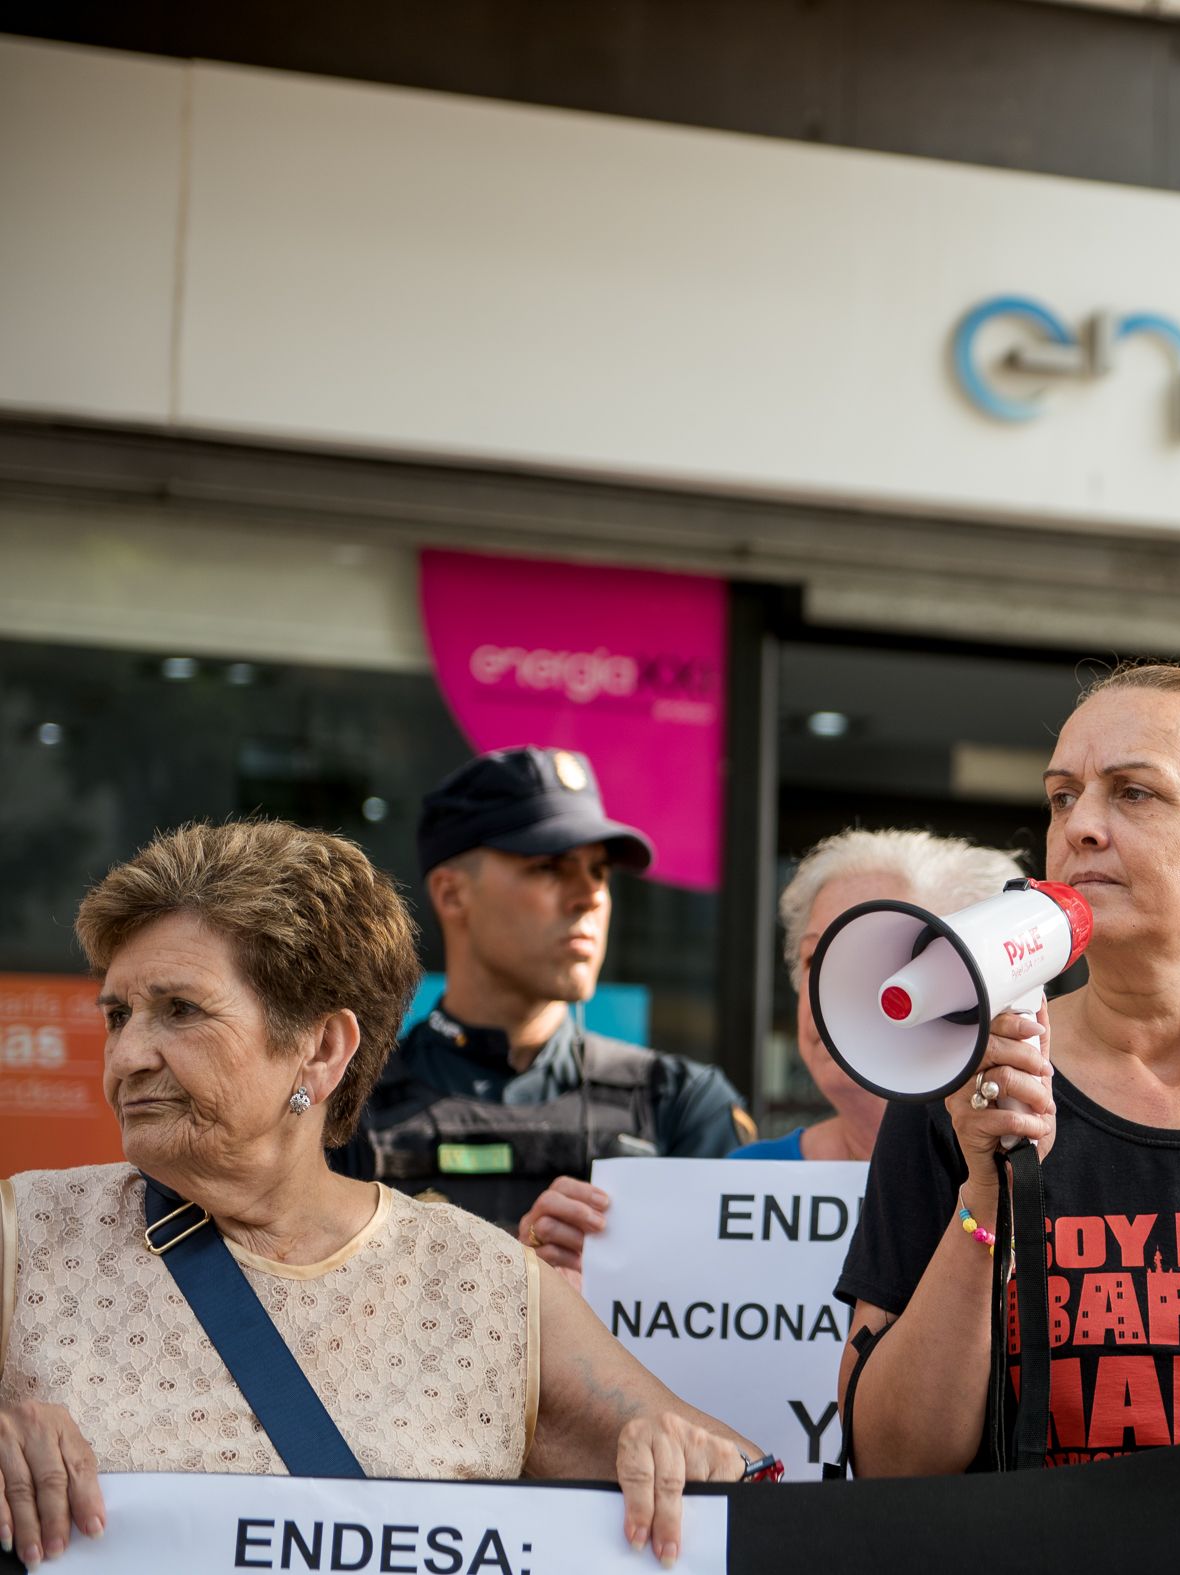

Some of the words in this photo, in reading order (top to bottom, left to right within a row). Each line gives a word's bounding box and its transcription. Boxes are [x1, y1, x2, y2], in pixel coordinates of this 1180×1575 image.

[718, 1194, 864, 1242] END
[1045, 1214, 1158, 1269] OY
[612, 1300, 854, 1342] NACIONA
[787, 1400, 851, 1463] Y
[234, 1517, 532, 1575] ENDESA:
